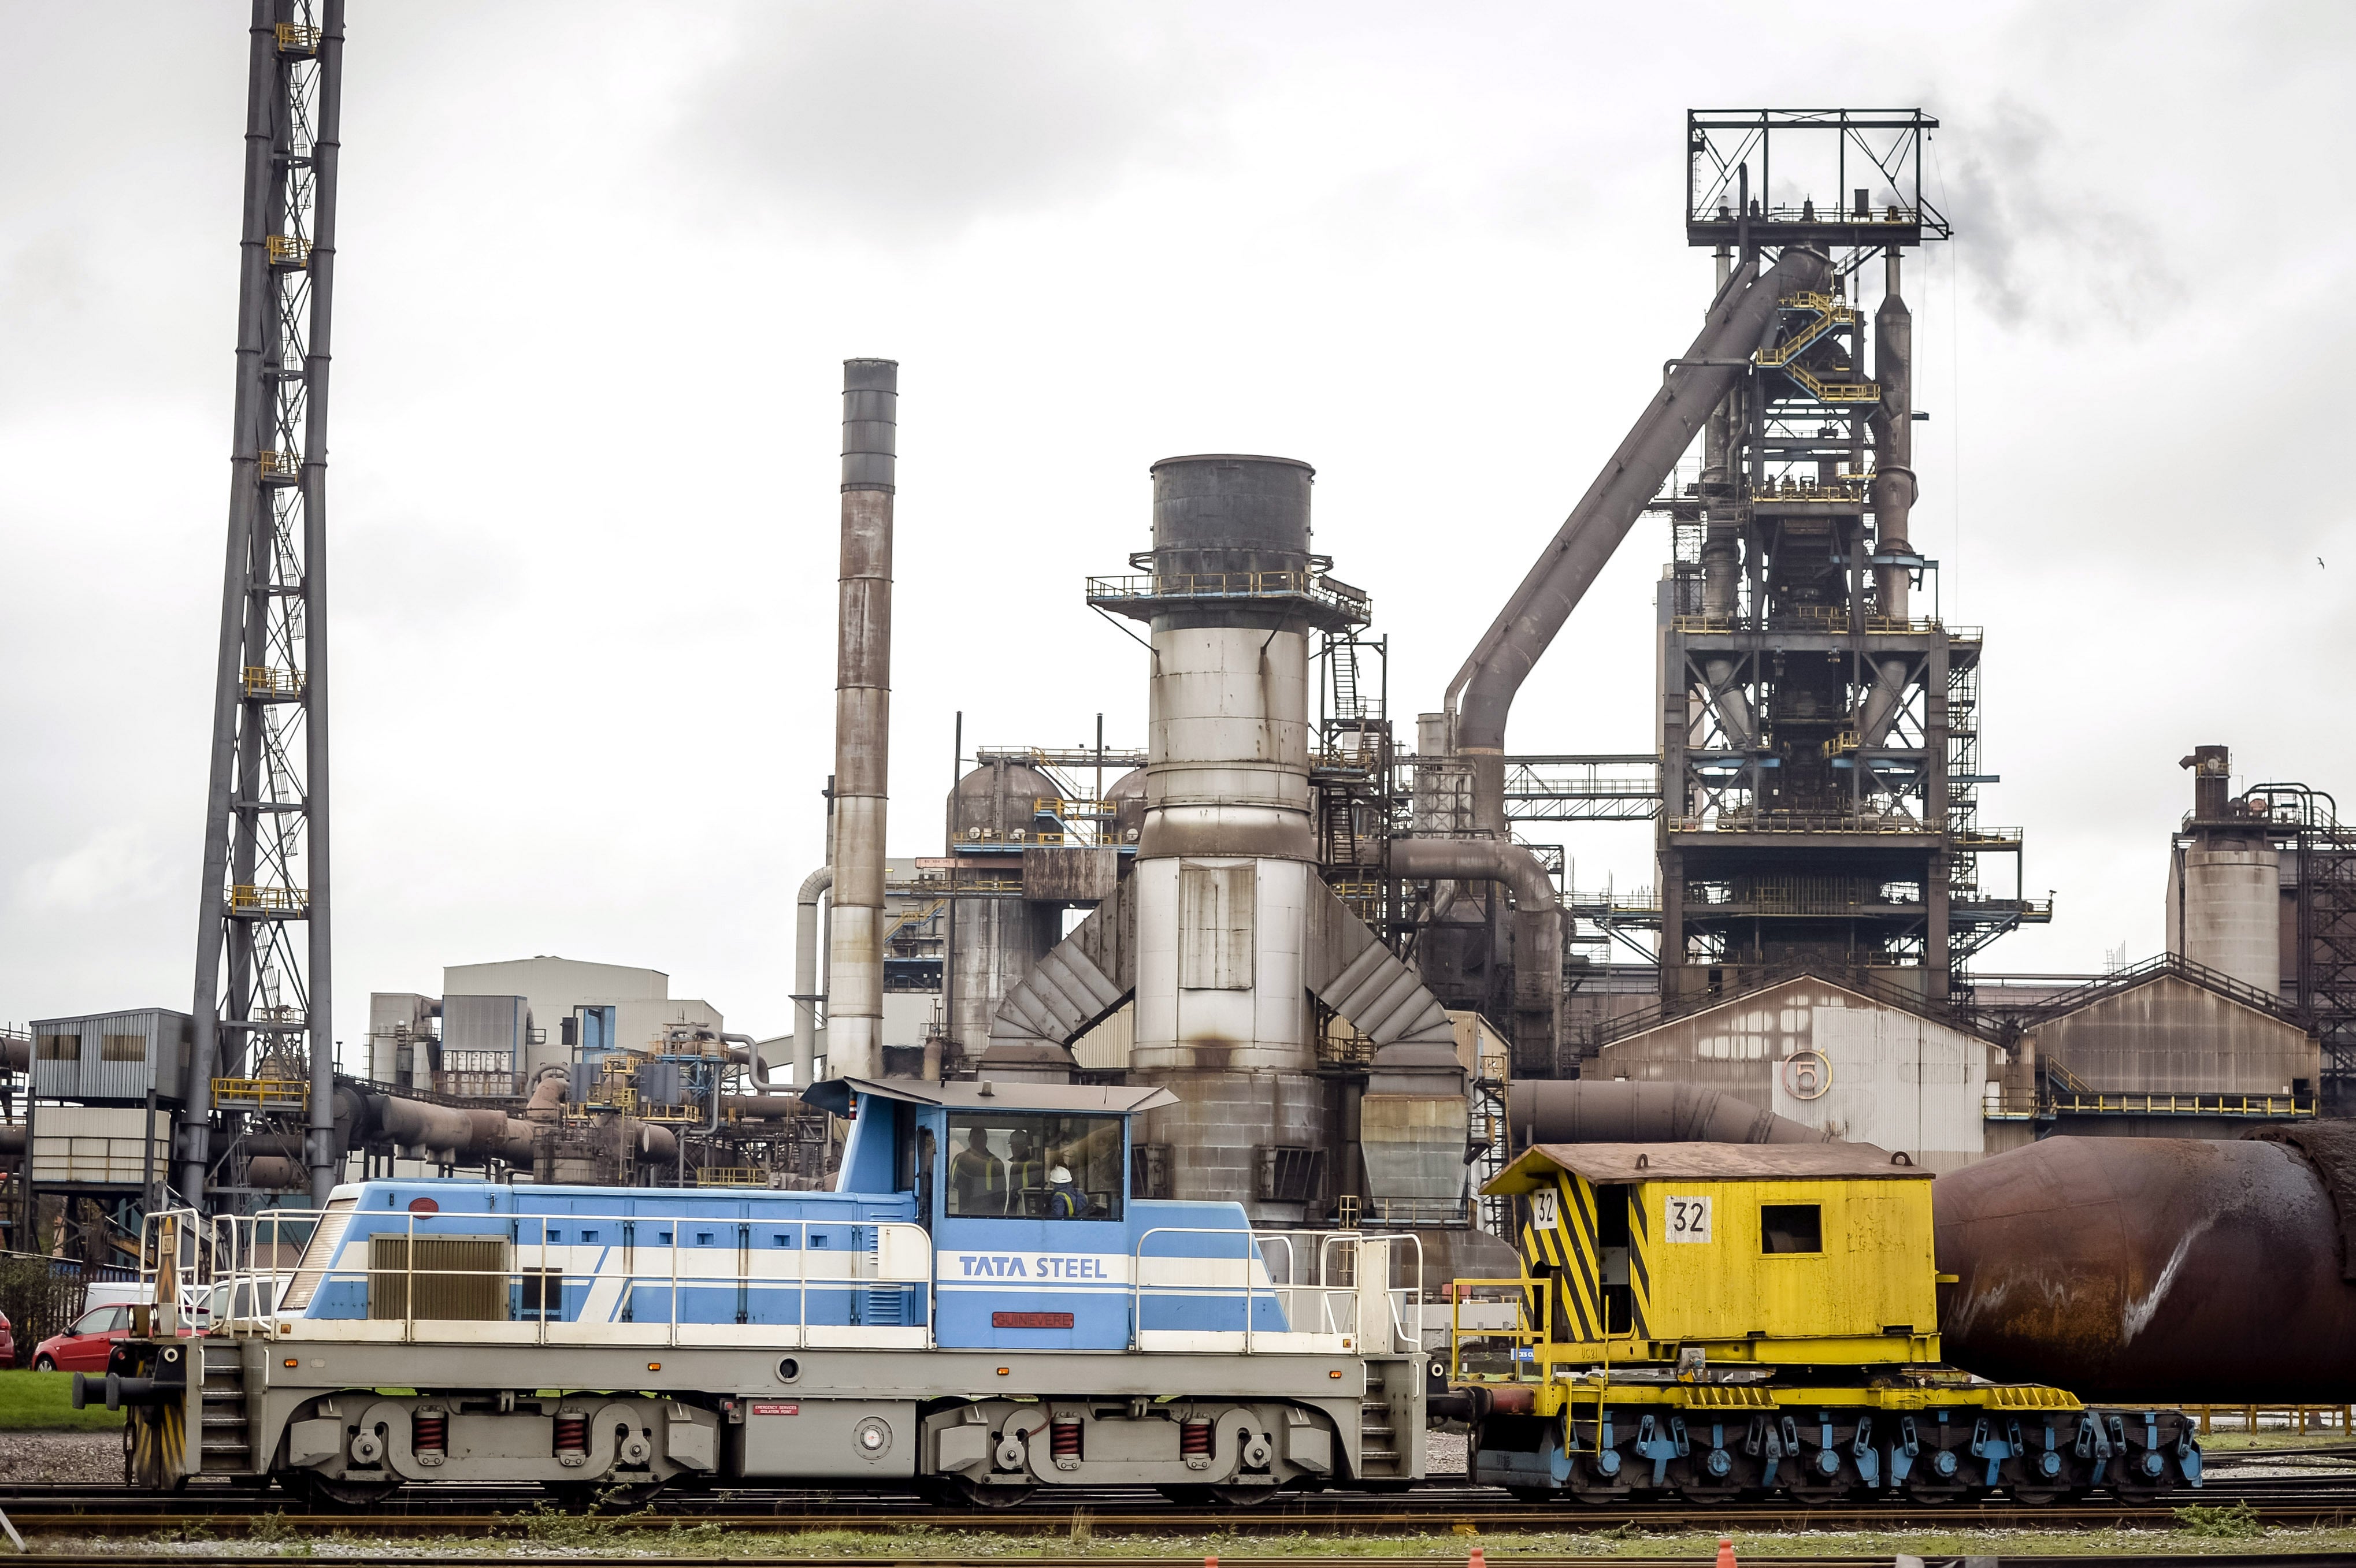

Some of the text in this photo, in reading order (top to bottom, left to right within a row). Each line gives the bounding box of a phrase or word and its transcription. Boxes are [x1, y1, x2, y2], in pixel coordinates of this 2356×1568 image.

[1797, 1061, 1817, 1090] 5
[1538, 1193, 1553, 1221] 32
[1673, 1202, 1704, 1232] 32
[959, 1256, 1107, 1279] TATA STEEL
[997, 1314, 1071, 1326] GUINEVERE
